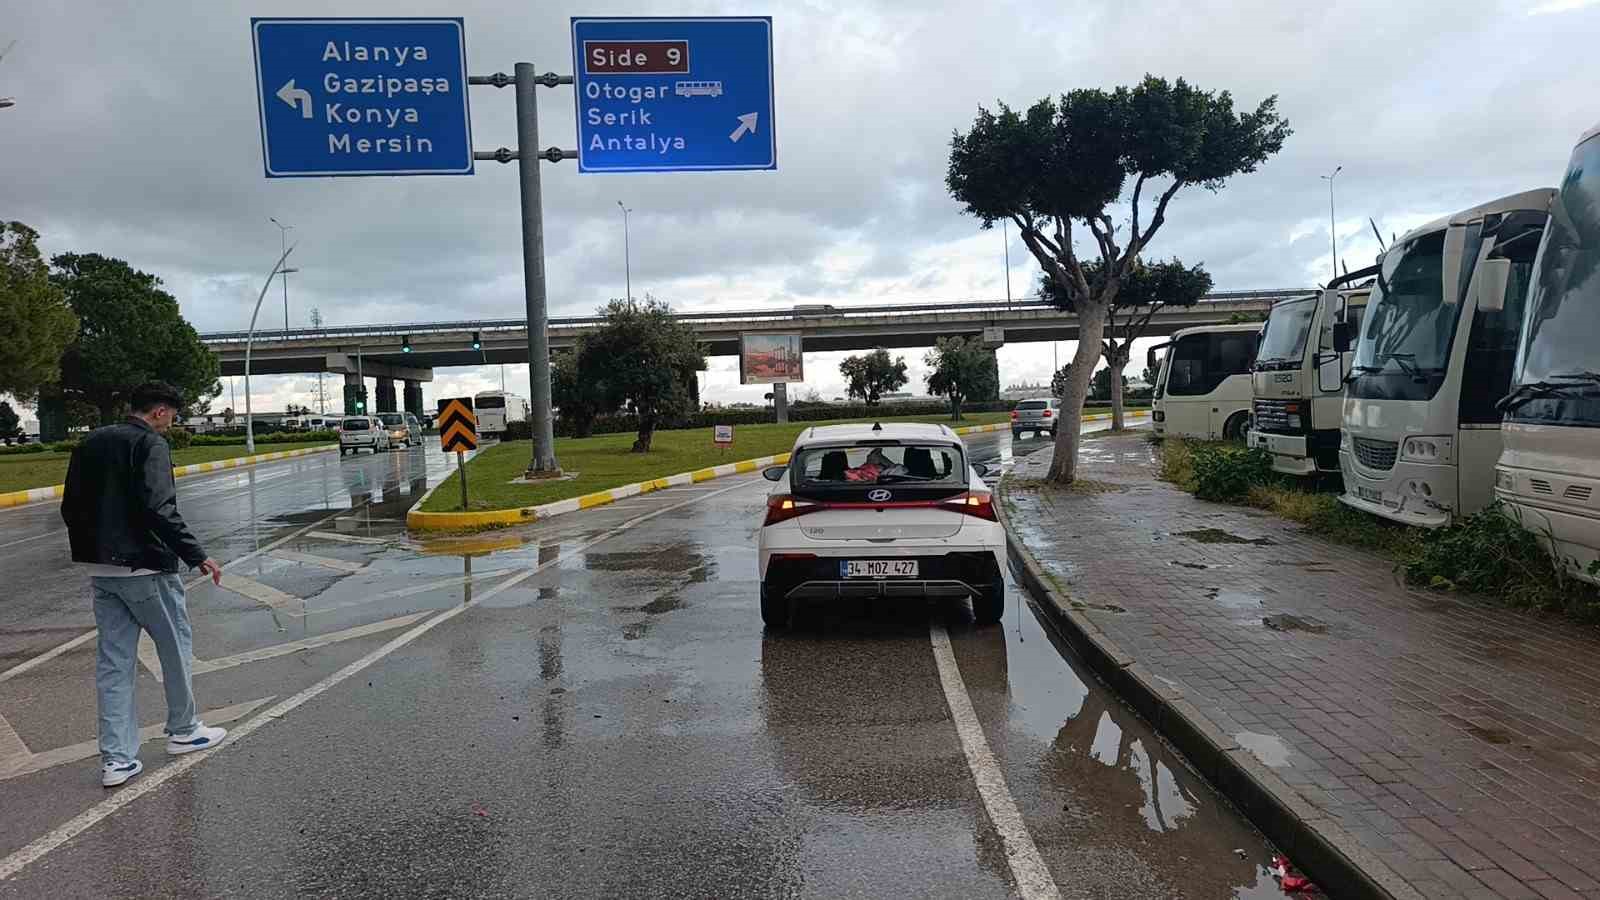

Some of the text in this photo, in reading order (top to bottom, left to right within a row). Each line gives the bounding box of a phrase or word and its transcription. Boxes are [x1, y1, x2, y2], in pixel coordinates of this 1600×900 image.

[322, 41, 428, 67] Alanya
[592, 48, 681, 66] Side 9
[324, 72, 450, 98] Gazipaşa
[586, 81, 669, 104] Otogar
[326, 103, 419, 128] Konya
[588, 107, 652, 125] Serik
[328, 133, 433, 154] Mersin
[589, 133, 686, 154] Antalya
[848, 562, 861, 575] 34
[867, 562, 888, 574] MOZ
[894, 562, 914, 574] 427
